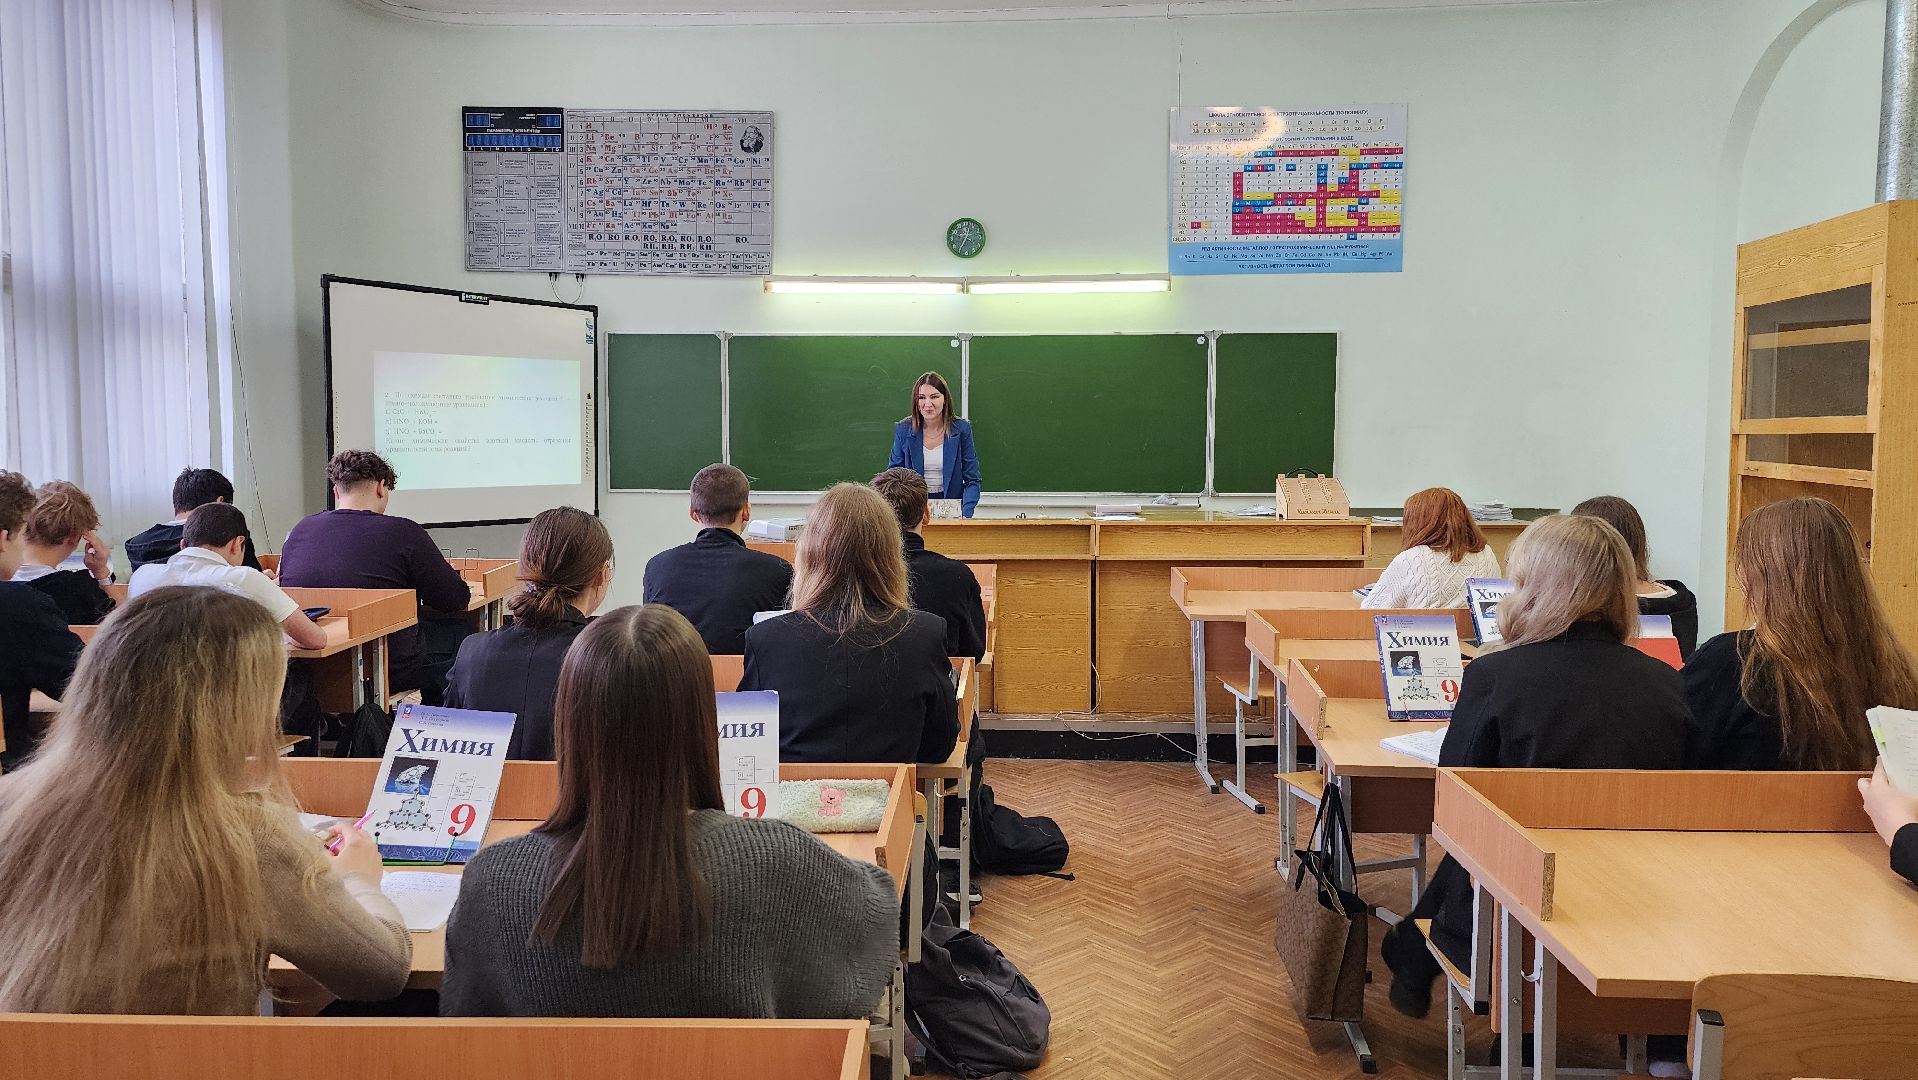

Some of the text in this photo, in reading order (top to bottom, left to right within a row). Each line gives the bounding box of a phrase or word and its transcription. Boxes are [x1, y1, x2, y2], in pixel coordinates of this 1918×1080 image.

[1474, 589, 1511, 600] Хим
[1386, 631, 1449, 649] Химия
[1441, 679, 1458, 702] 9
[718, 722, 765, 738] мия
[395, 728, 496, 757] Химия
[740, 787, 766, 819] 9
[447, 803, 476, 837] 9
